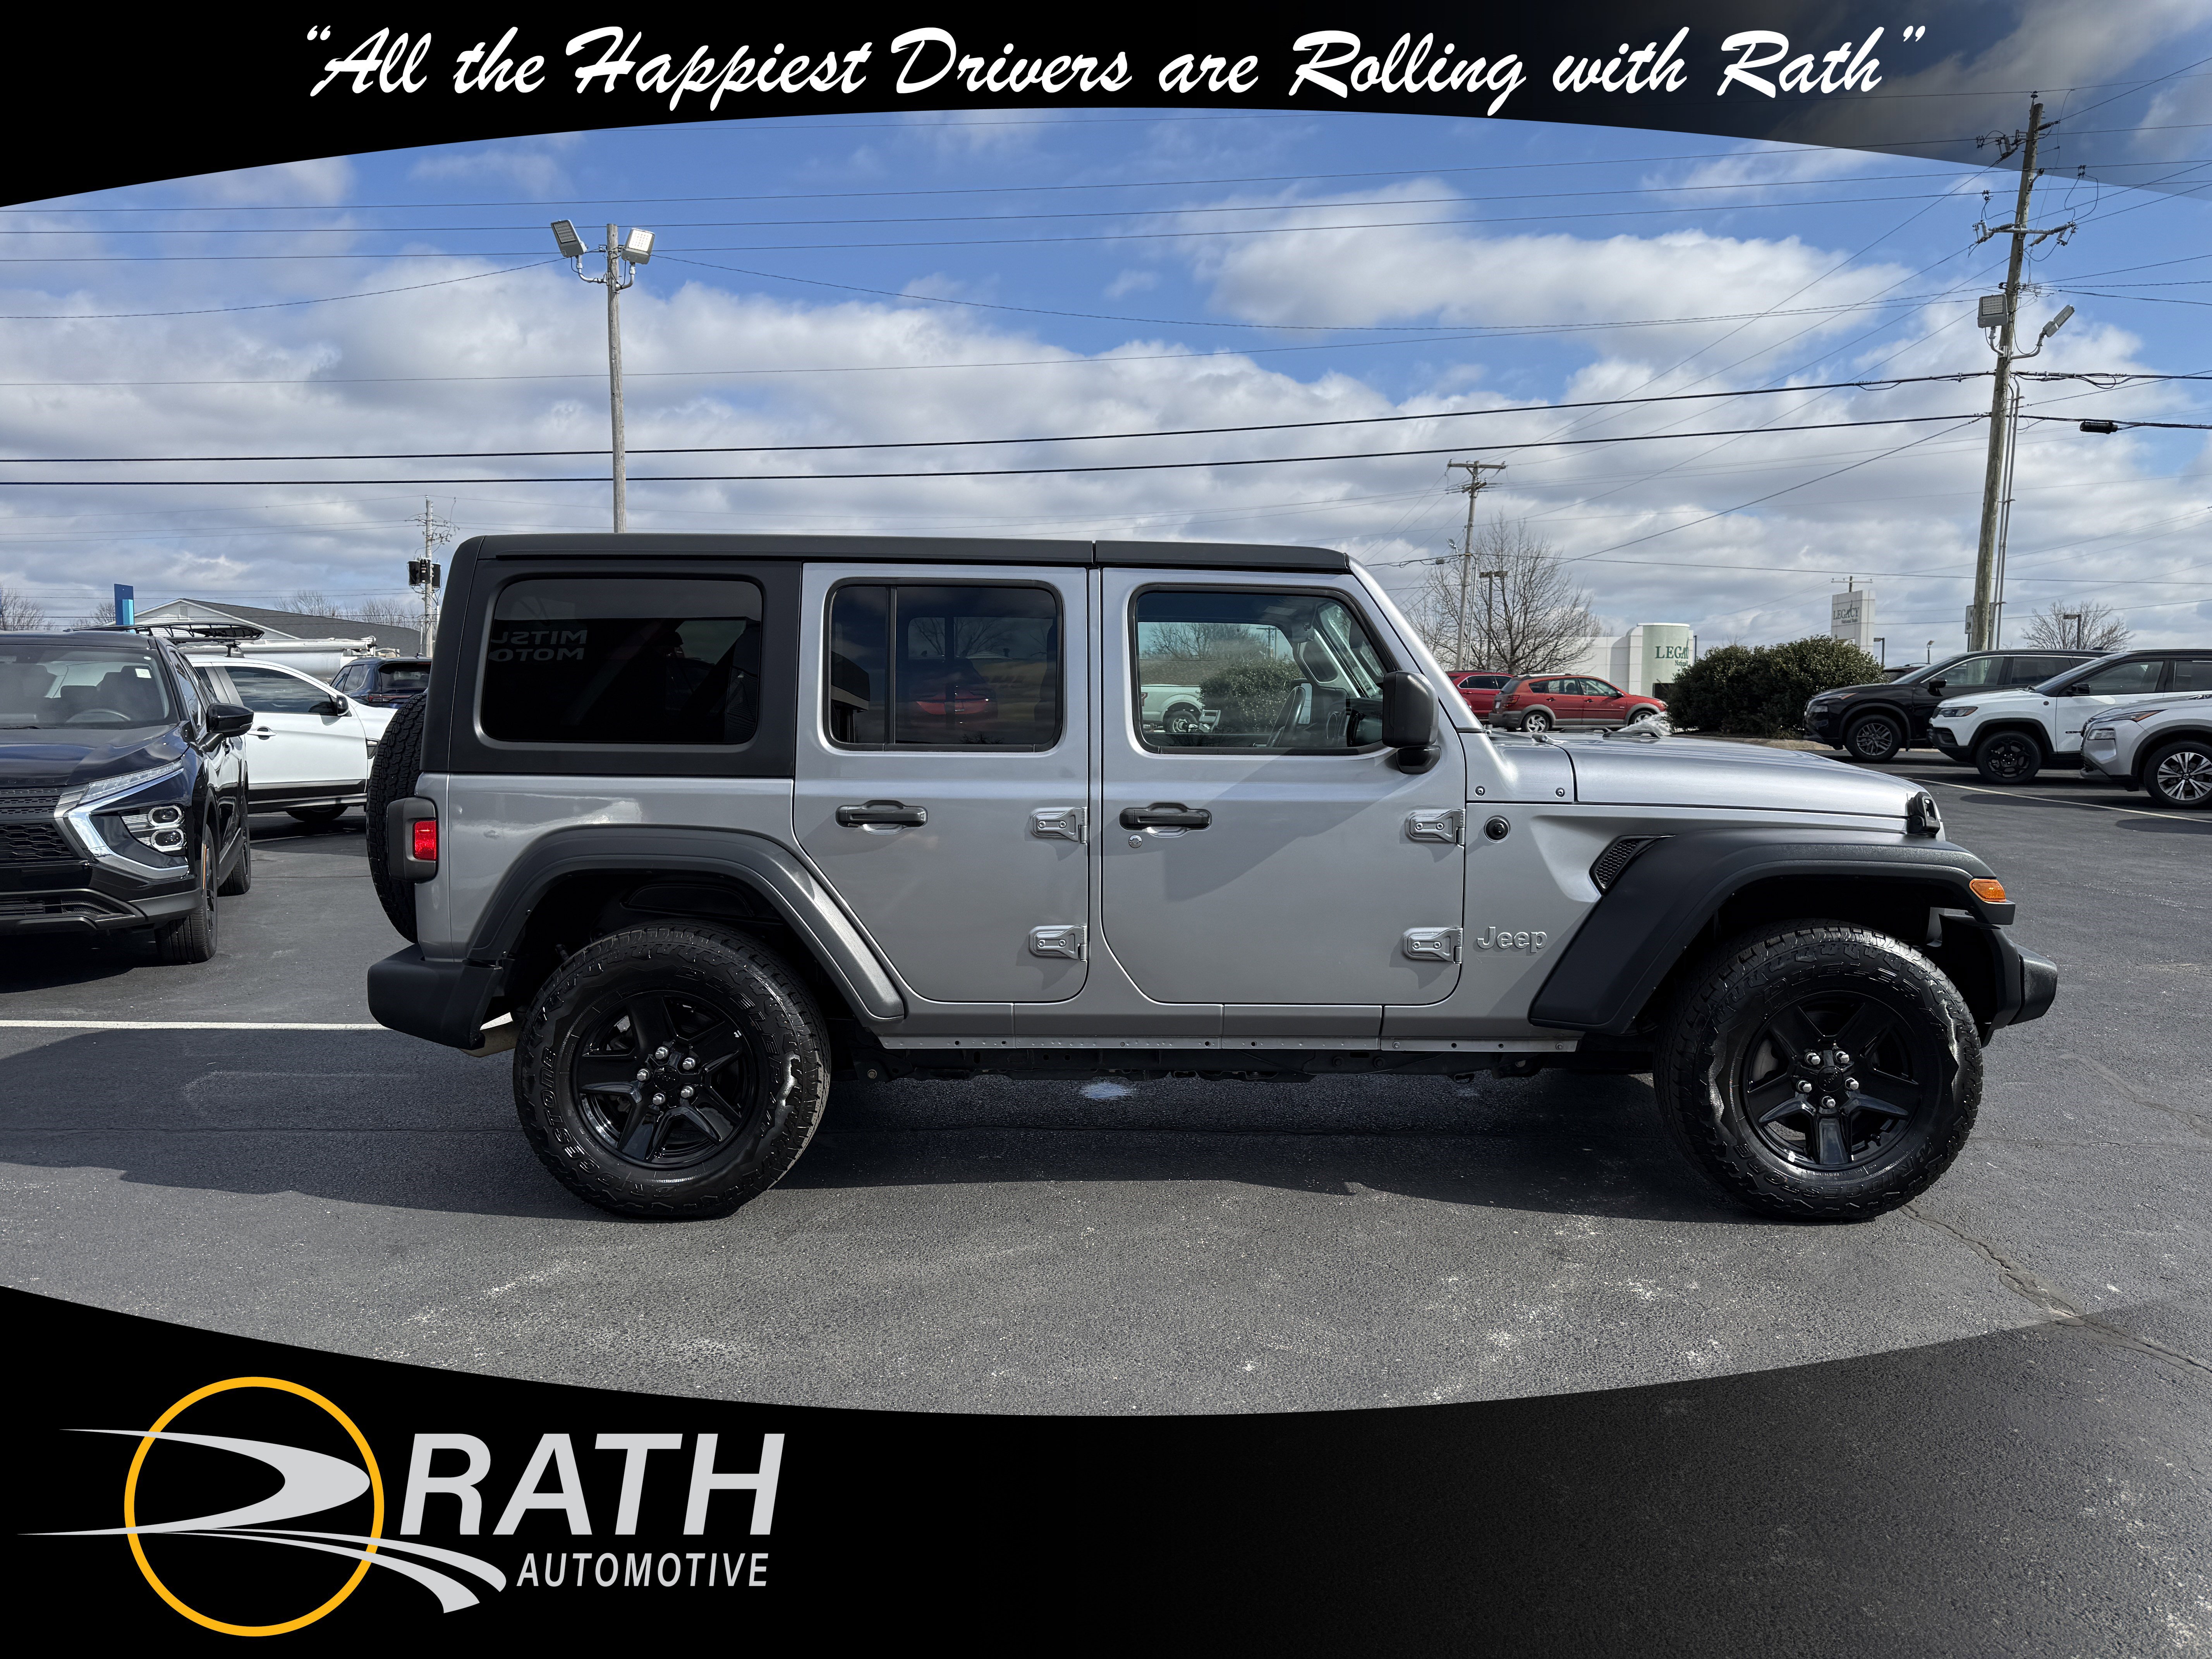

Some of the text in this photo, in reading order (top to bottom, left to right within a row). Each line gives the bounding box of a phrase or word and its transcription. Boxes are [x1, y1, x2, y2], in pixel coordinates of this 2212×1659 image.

[1833, 599, 1859, 620] LEGACY
[1477, 927, 1547, 953] Jeep
[539, 1046, 676, 1198] BRIDGESTONE
